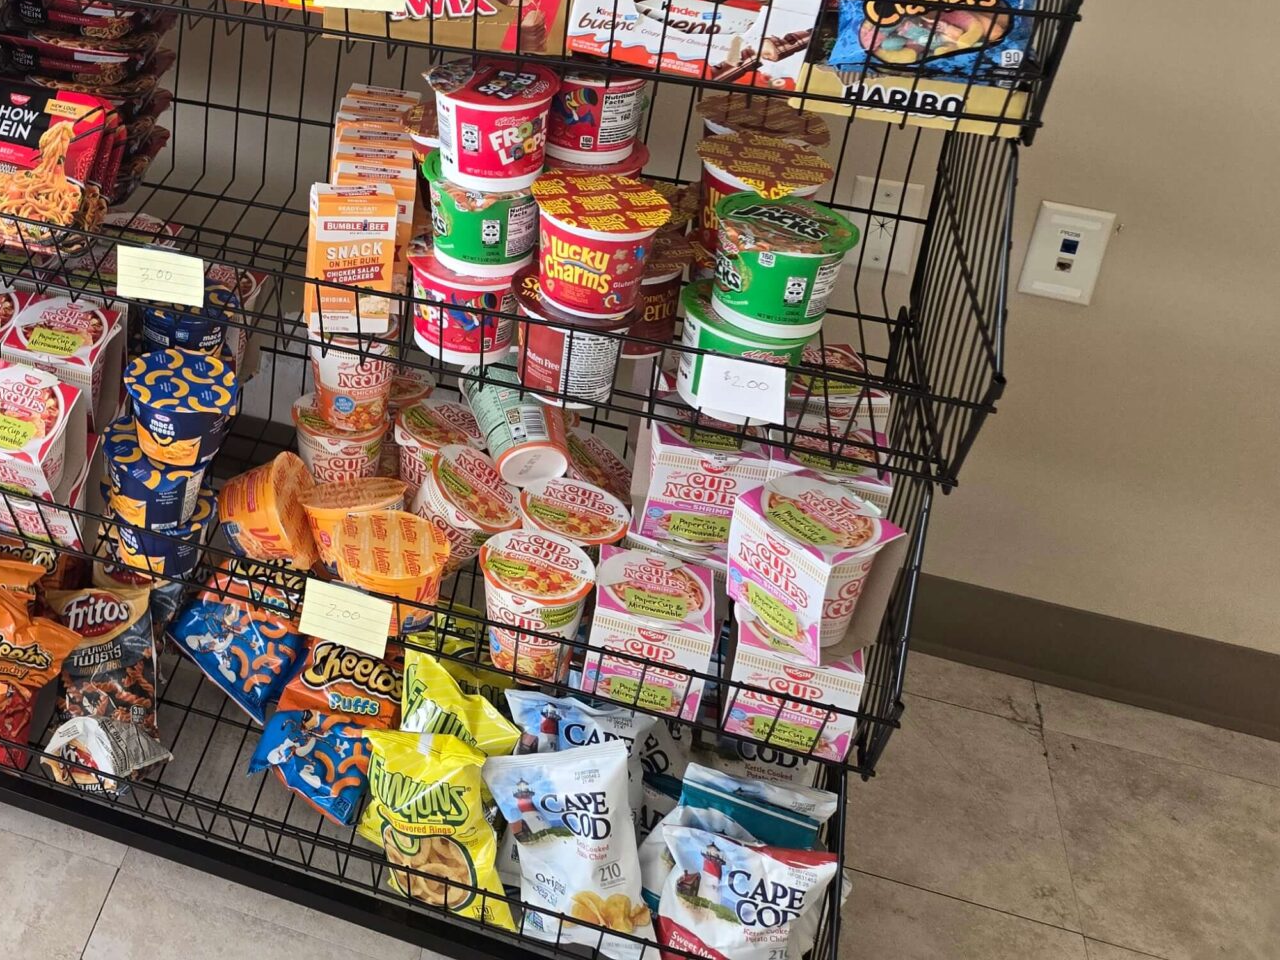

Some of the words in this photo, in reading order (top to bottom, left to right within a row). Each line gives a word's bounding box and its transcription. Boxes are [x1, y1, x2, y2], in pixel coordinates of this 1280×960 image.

[20, 3, 42, 13] CHOW
[21, 9, 42, 19] MEIN
[1004, 52, 1020, 64] 90
[604, 92, 636, 102] Nutrition
[843, 84, 965, 120] HARIBO
[488, 111, 548, 152] FROOT
[500, 131, 546, 165] LOOPS
[730, 205, 831, 241] JACKS
[327, 242, 383, 259] SNACK
[550, 236, 610, 273] Lucky
[140, 267, 173, 282] 3.00
[326, 267, 356, 277] CHICKEN
[358, 266, 380, 274] SALAD
[545, 255, 613, 294] Charms
[42, 311, 91, 329] NOODLES
[723, 370, 769, 392] $2.00
[328, 457, 369, 471] CUP
[686, 473, 738, 492] CUP
[545, 485, 615, 515] NOODLES
[549, 499, 586, 514] CHICKEN
[693, 505, 730, 516] SHRIMP
[672, 525, 724, 539] Microwavable
[506, 539, 579, 570] NOODLES
[64, 596, 130, 628] Fritos
[326, 603, 360, 621] 2.00
[628, 601, 682, 618] Microwavable
[639, 630, 665, 639] NISSIN
[72, 647, 122, 666] TWISTS
[81, 643, 114, 657] FLAVOR
[624, 640, 675, 661] CUP
[304, 643, 404, 696] Cheetos
[769, 678, 823, 700] CUP
[329, 693, 379, 715] Puffs
[744, 763, 762, 774] Kettle
[766, 770, 793, 781] Cooked
[369, 757, 469, 825] FUNYUNS
[541, 792, 609, 815] CAPE
[394, 820, 428, 834] Flavored
[428, 825, 452, 835] Rings
[561, 812, 612, 840] COD
[599, 863, 621, 881] 210
[728, 870, 806, 910] CAPE
